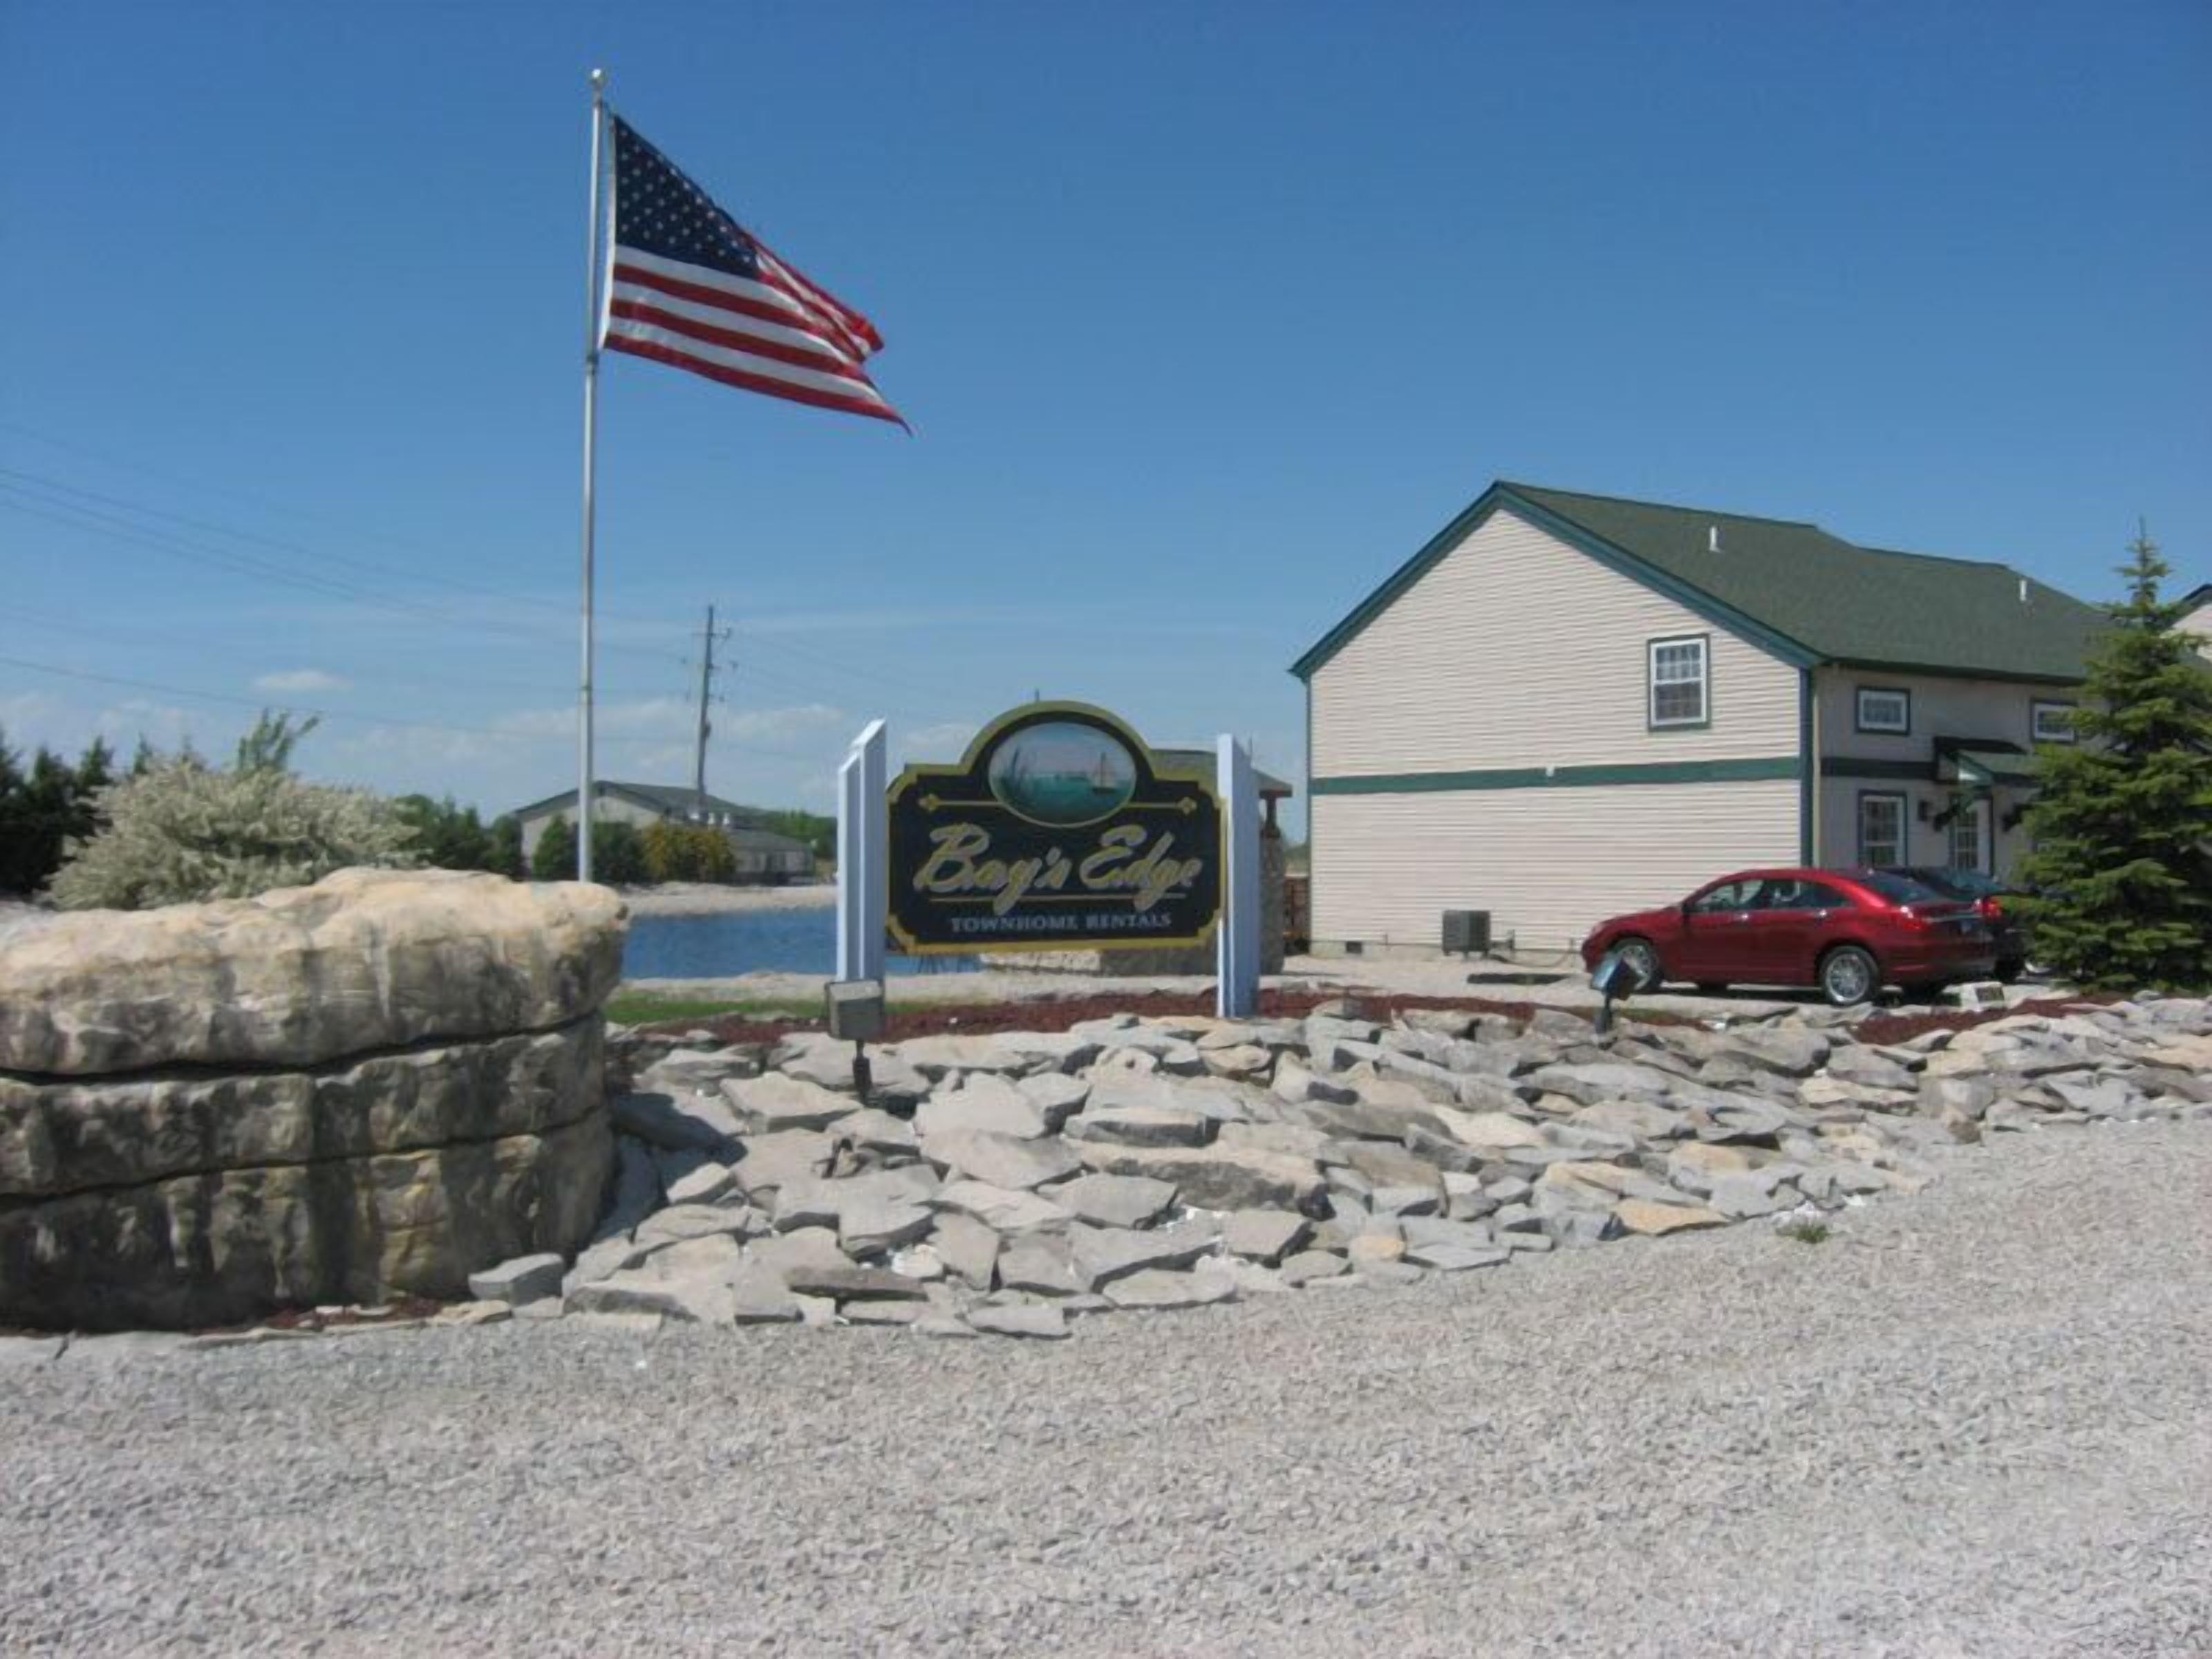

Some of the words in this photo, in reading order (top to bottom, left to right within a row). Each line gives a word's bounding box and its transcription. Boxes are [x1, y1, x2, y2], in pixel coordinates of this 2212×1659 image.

[912, 822, 1071, 915] Bay's
[1079, 825, 1203, 911] Edge
[951, 915, 1078, 932] TOWNHOME
[1086, 913, 1172, 929] RENTALS
